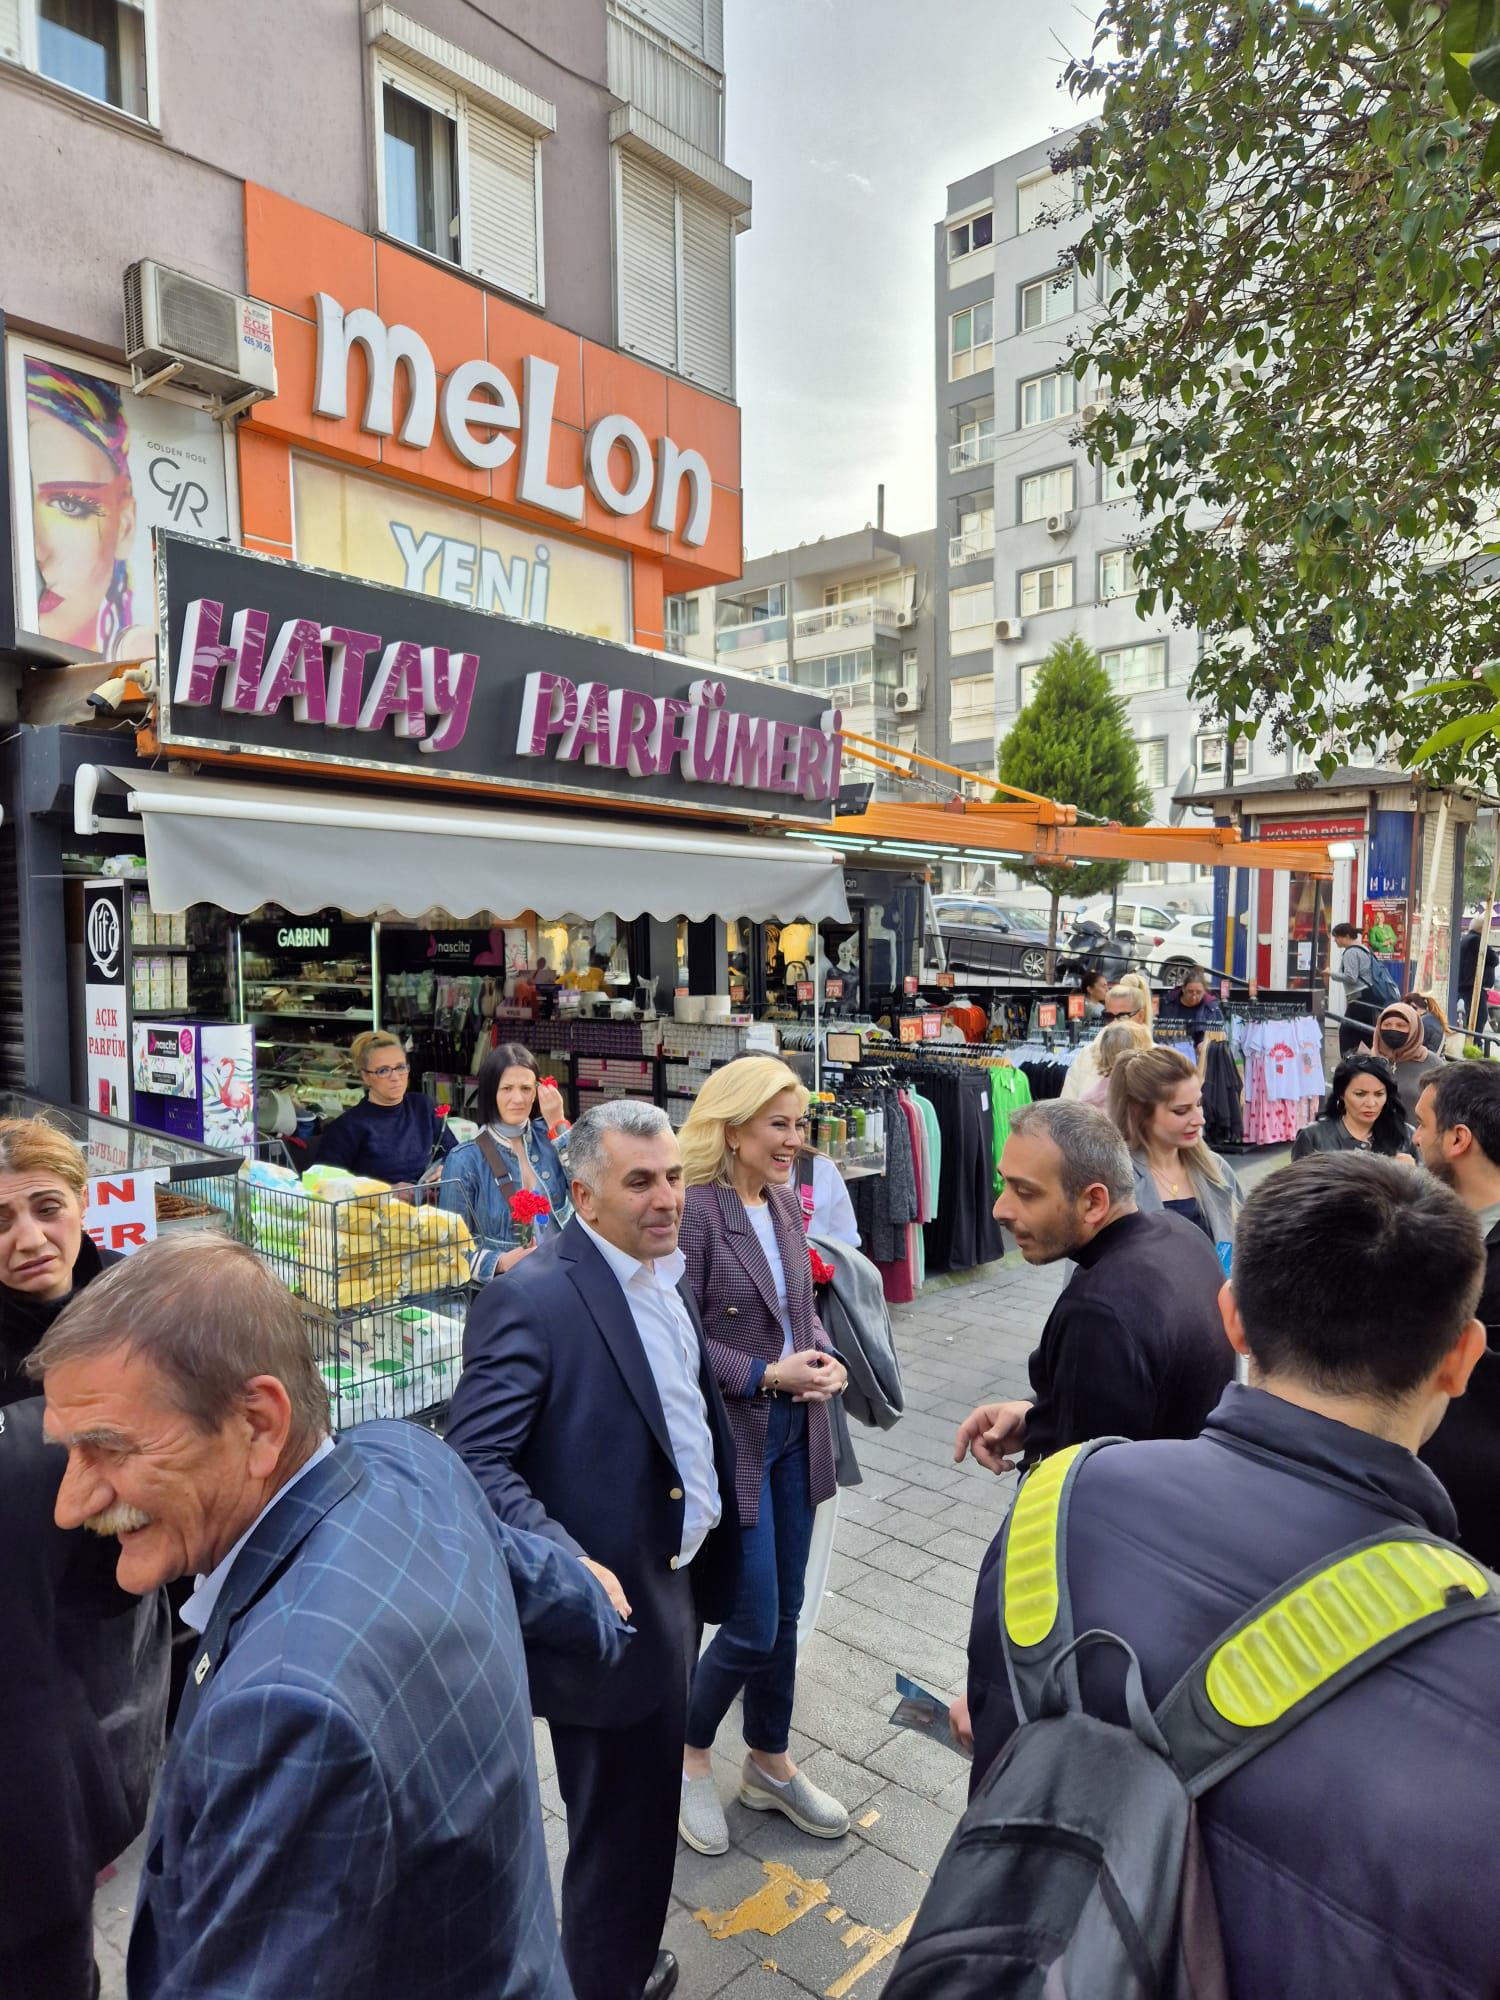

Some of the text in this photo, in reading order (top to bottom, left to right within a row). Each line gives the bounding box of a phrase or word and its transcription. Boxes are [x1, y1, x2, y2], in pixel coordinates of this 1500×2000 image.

[147, 441, 207, 465] GOLDEN ROSE
[516, 671, 843, 800] PARFÜMERİ
[277, 927, 329, 947] GABRINI
[437, 940, 471, 953] nascita
[95, 1008, 118, 1032] AÇIK
[902, 1026, 915, 1041] 99
[88, 1033, 126, 1059] PARFÜM
